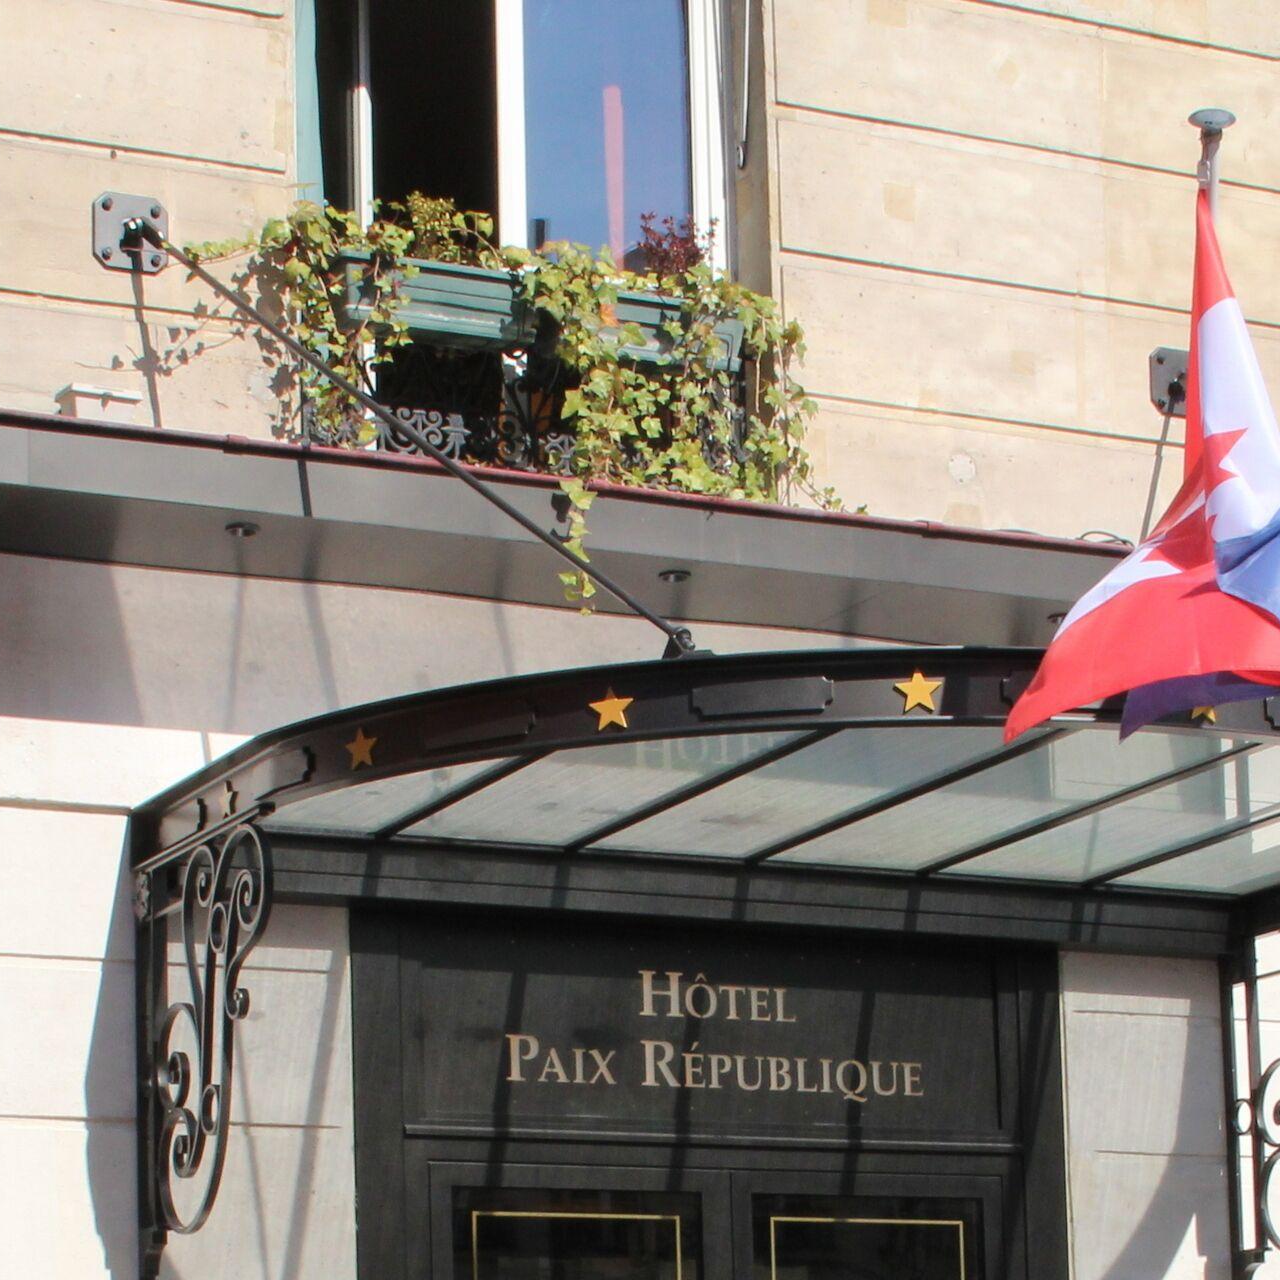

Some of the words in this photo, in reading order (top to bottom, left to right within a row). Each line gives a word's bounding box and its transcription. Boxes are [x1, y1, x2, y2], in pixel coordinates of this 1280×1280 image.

[639, 970, 797, 1023] HÔTEL
[505, 1033, 618, 1086] PAIX
[640, 1039, 924, 1103] RÉPUBLIQUE
